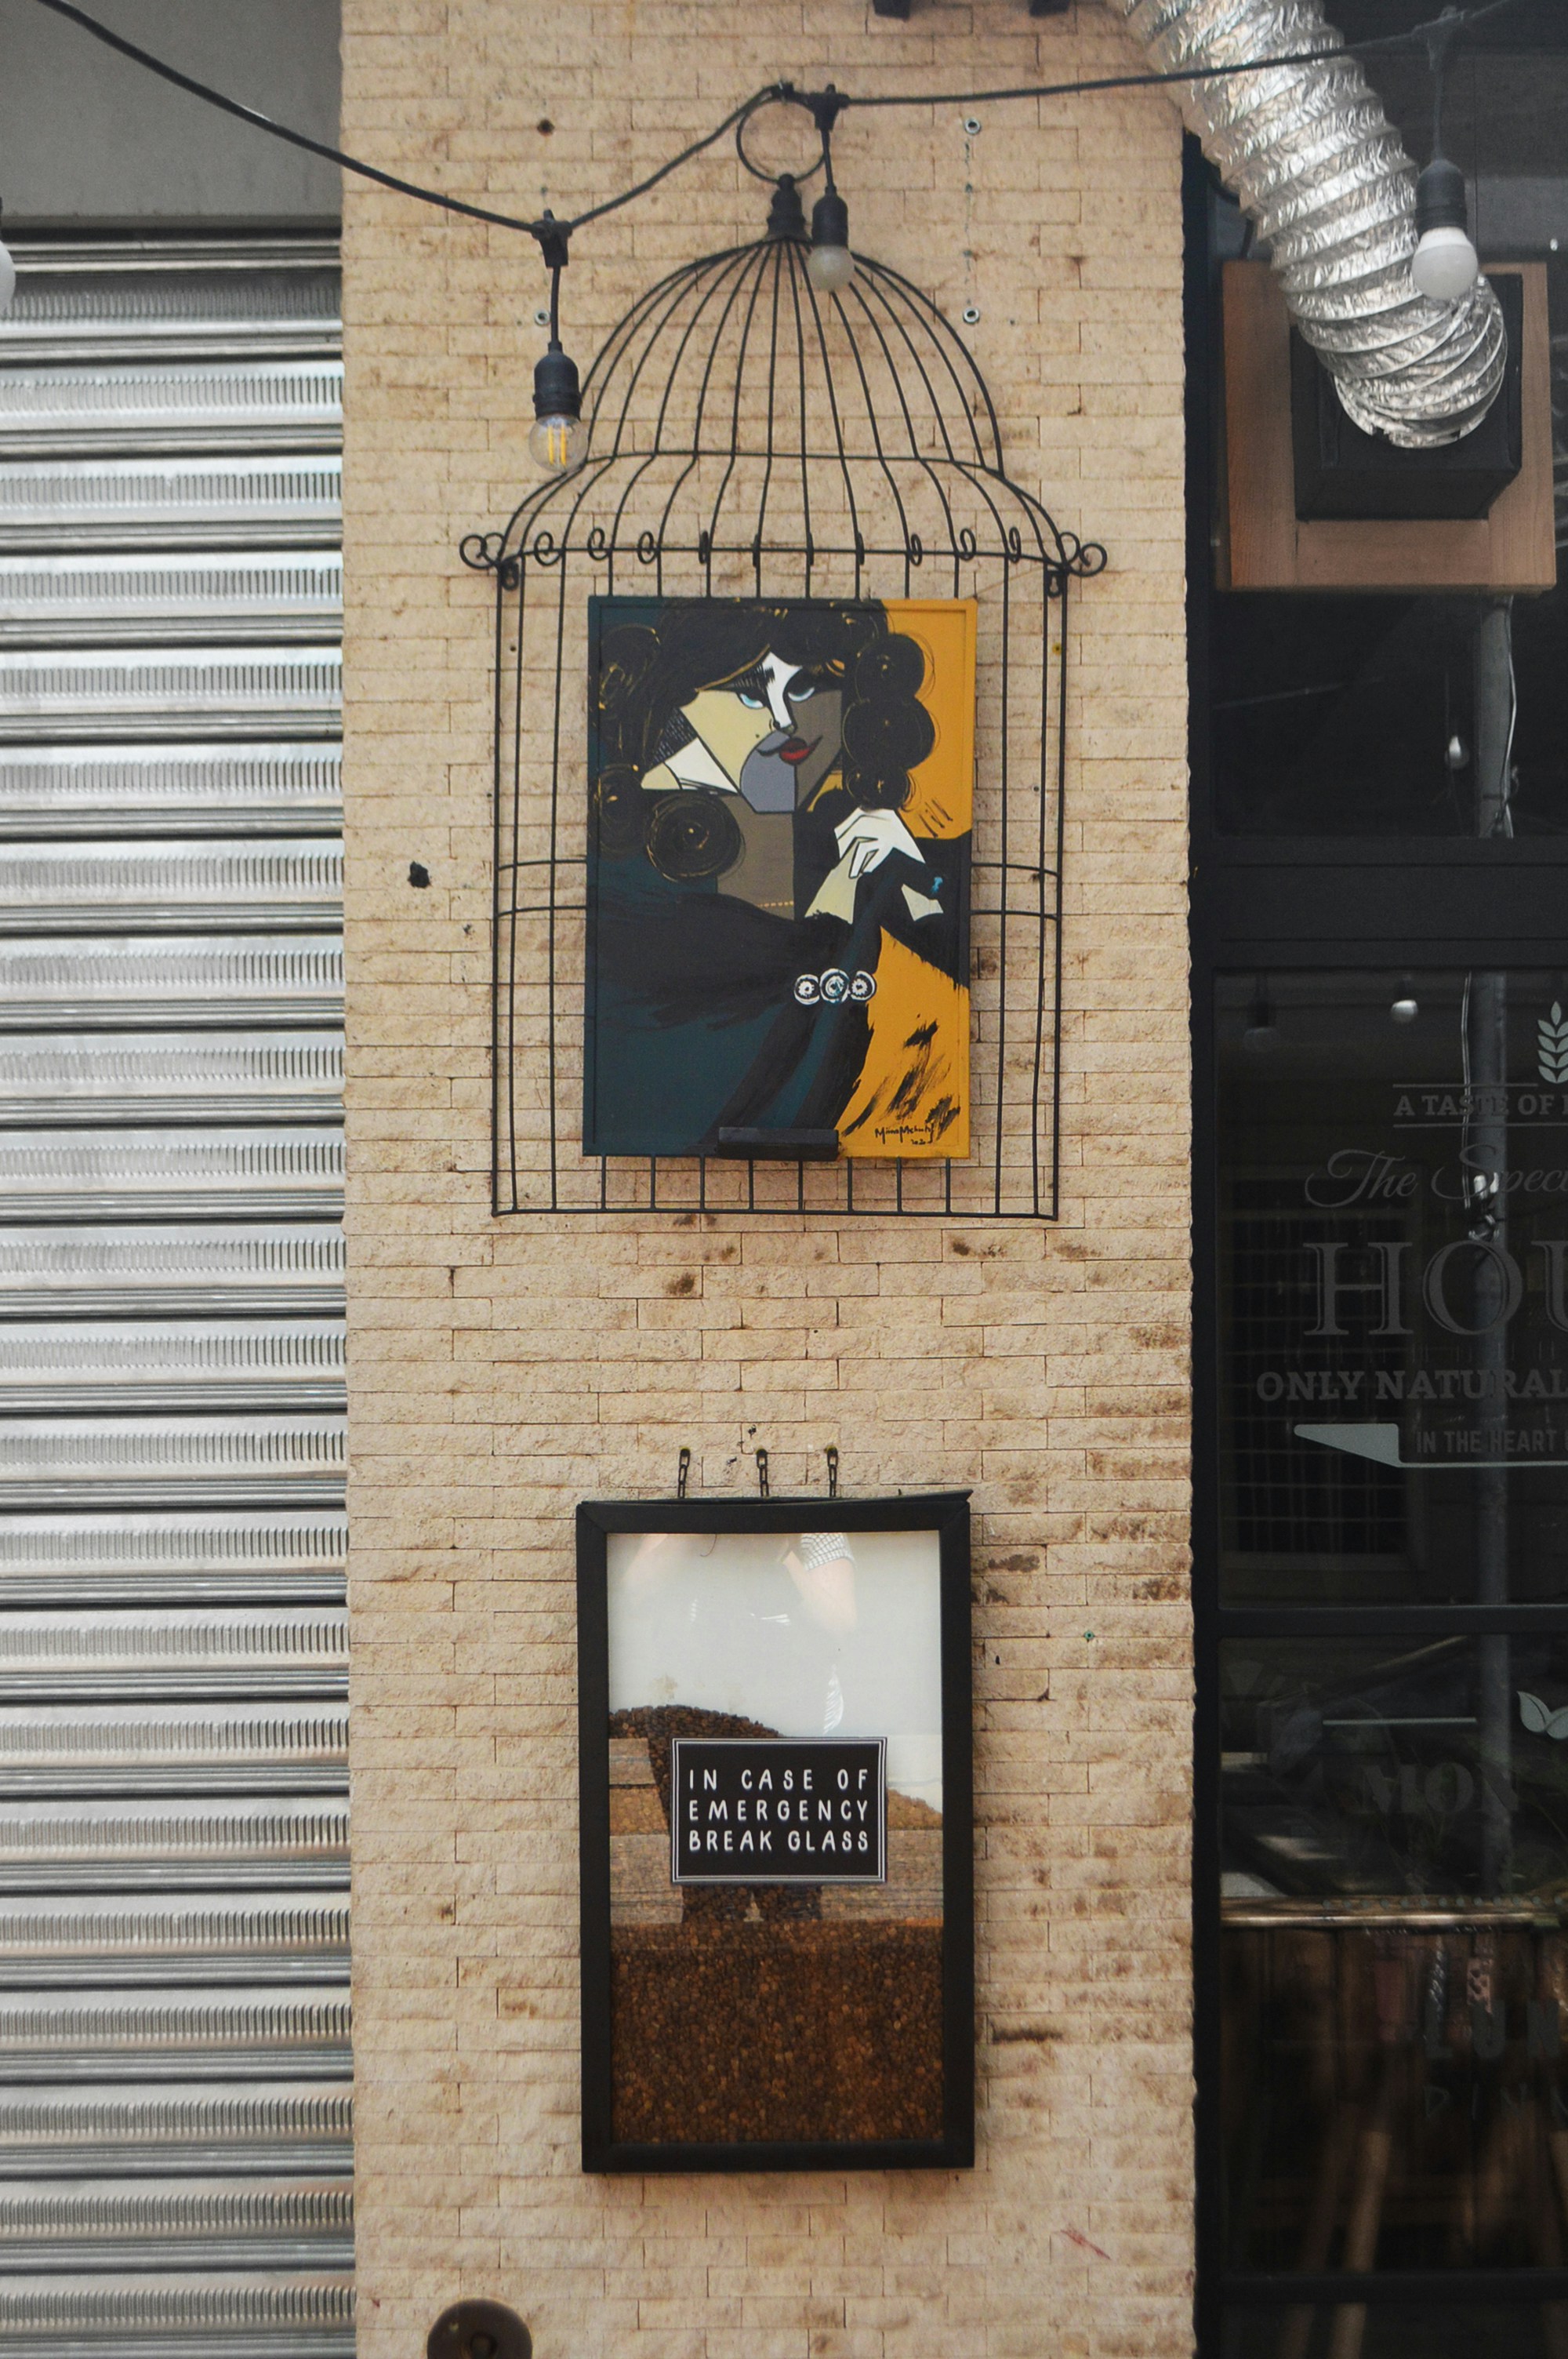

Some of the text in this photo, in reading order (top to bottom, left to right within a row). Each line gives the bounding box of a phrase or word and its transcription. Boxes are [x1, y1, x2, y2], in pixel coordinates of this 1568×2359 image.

[1392, 1096, 1416, 1117] A
[1421, 1095, 1510, 1117] TASTE
[1517, 1094, 1555, 1116] OF
[1304, 1148, 1419, 1208] The
[1256, 1369, 1568, 1402] ONLY NATURAL
[1416, 1430, 1436, 1453] IN
[1443, 1430, 1482, 1453] THE
[1490, 1429, 1558, 1453] HEART
[689, 1768, 868, 1790] IN CASE OF
[689, 1799, 868, 1821] EMERGENCY
[689, 1830, 869, 1852] BREAK GLASS
